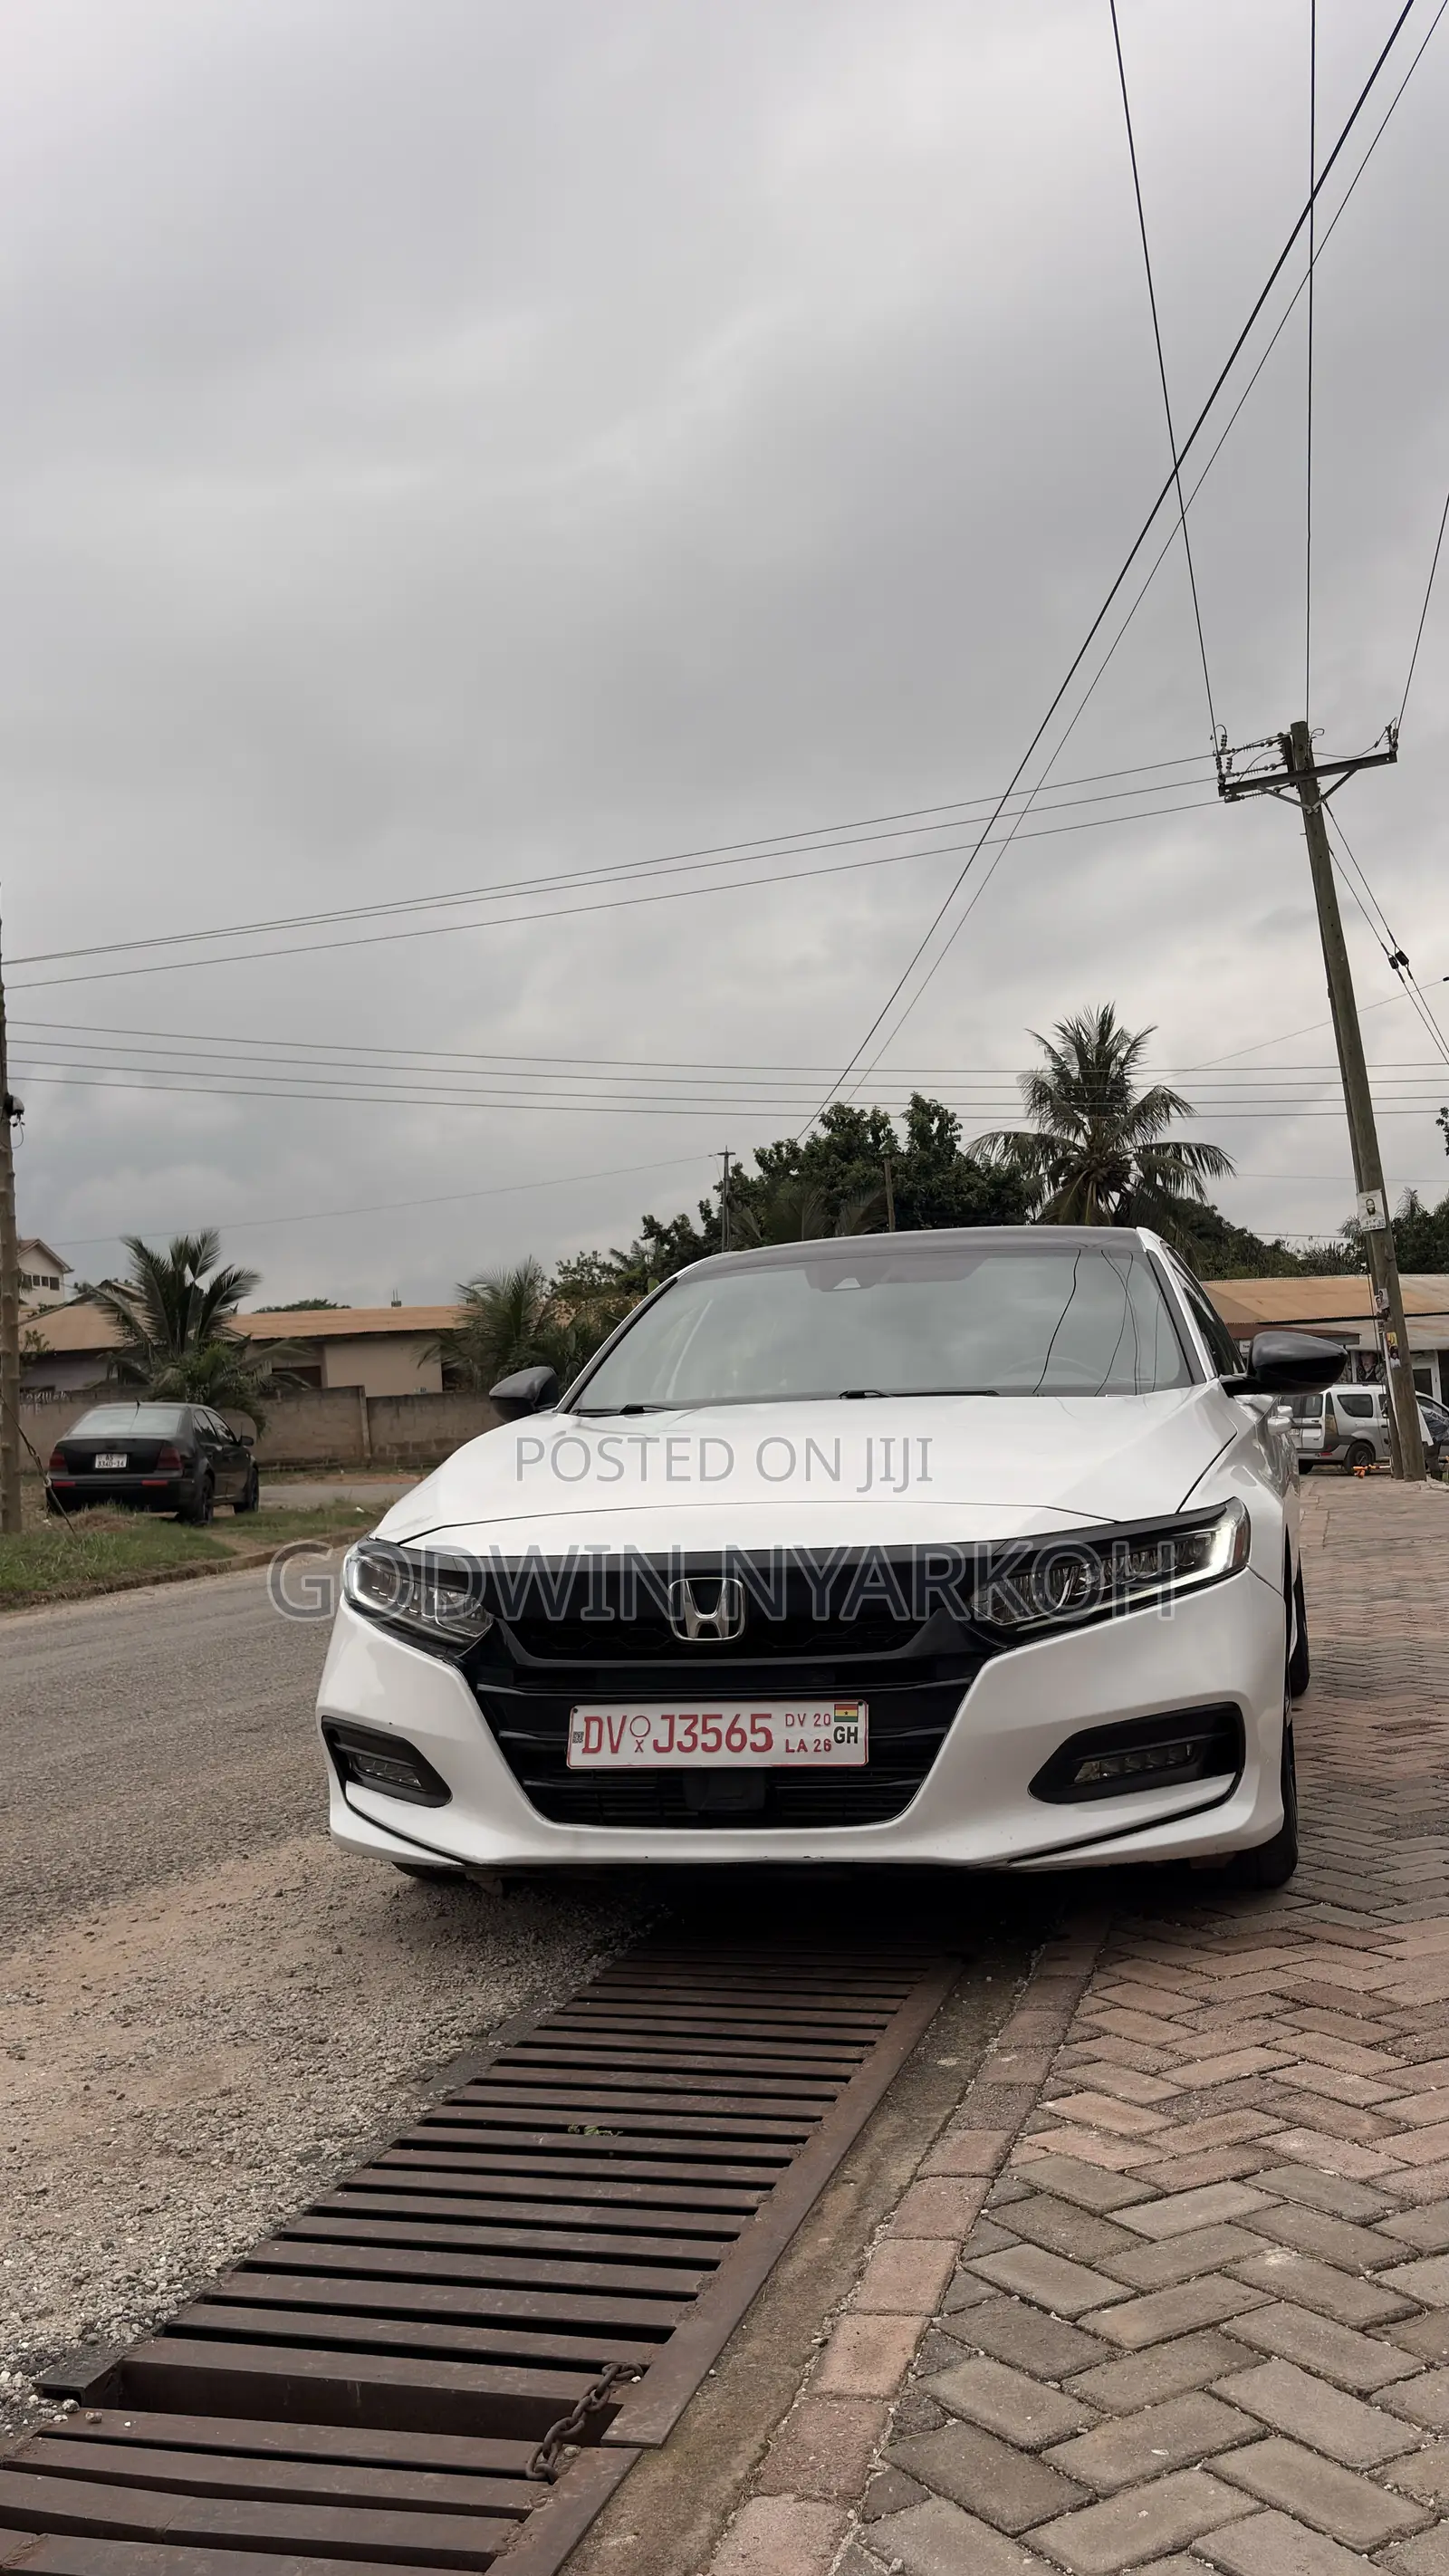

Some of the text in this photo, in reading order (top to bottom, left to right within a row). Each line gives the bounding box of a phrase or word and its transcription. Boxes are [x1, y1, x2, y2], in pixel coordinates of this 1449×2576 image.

[785, 1713, 831, 1727] DV 20
[582, 1715, 627, 1754] DV
[653, 1714, 774, 1754] J3565
[833, 1725, 859, 1745] GH
[785, 1738, 808, 1754] LA
